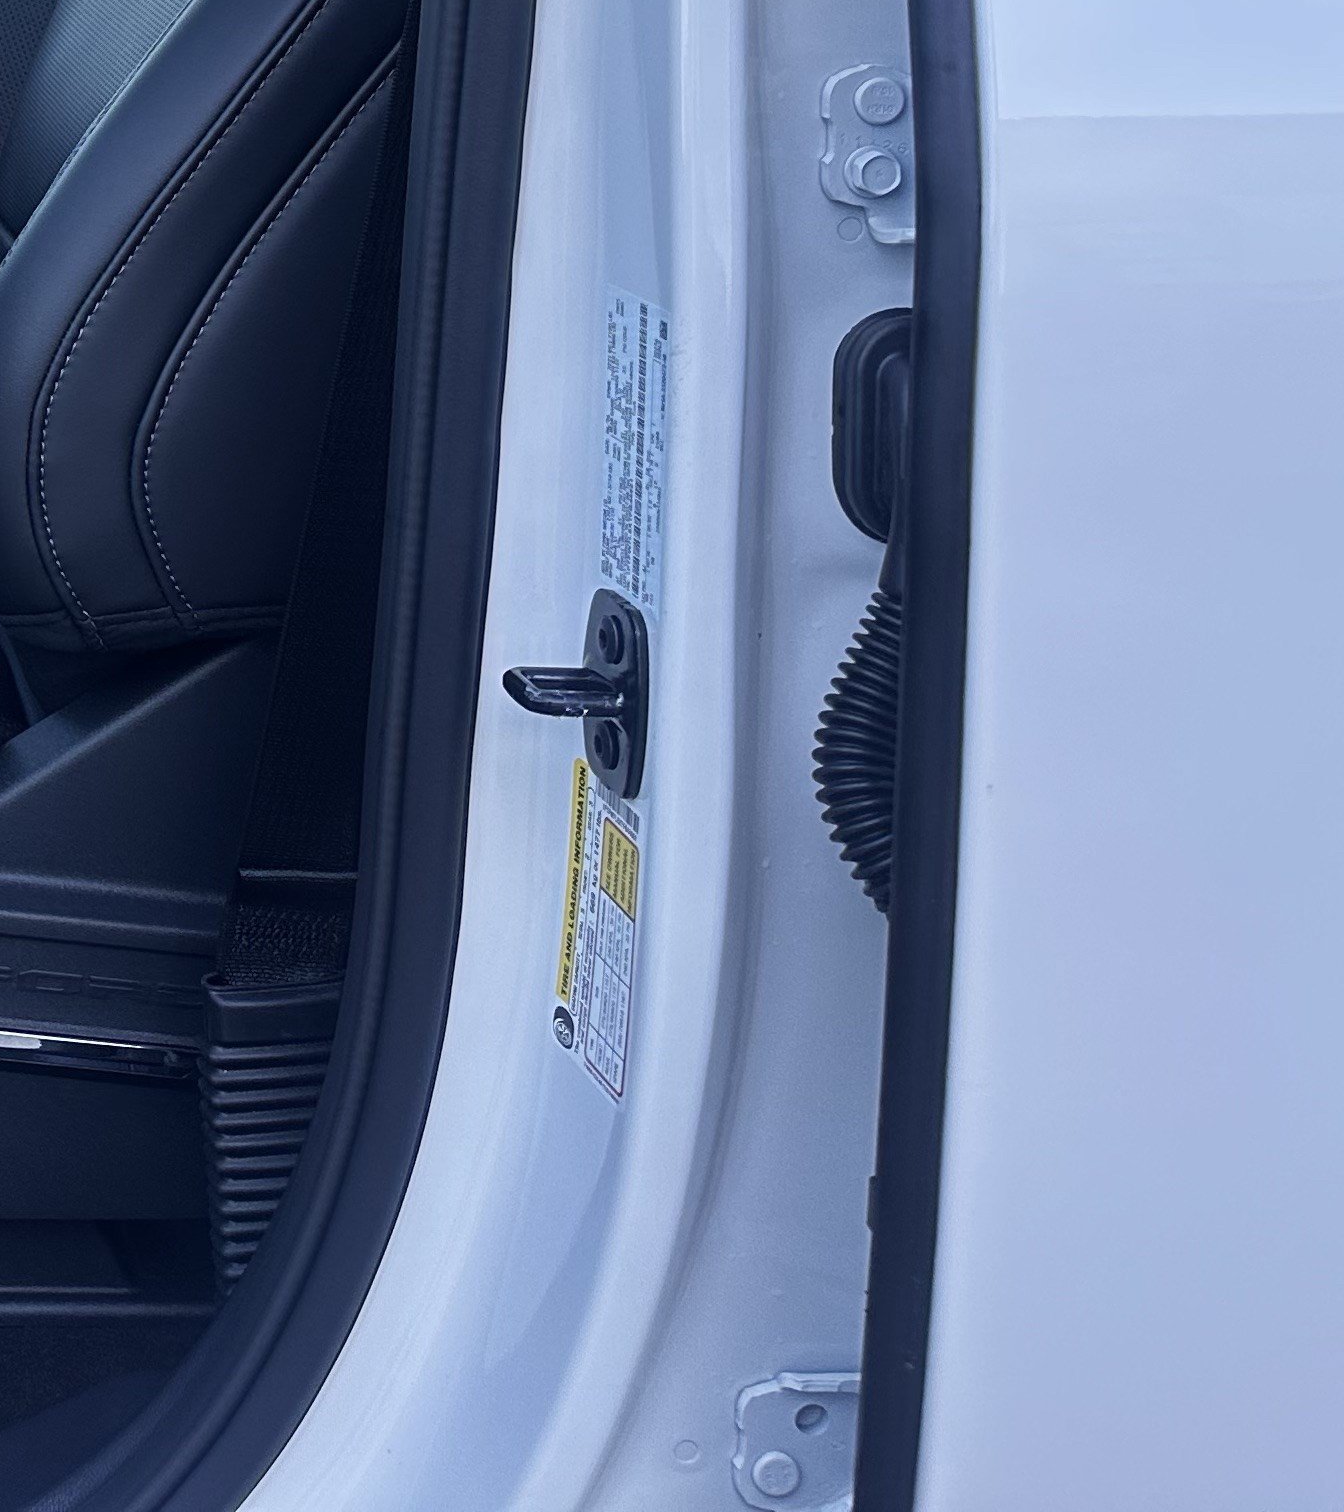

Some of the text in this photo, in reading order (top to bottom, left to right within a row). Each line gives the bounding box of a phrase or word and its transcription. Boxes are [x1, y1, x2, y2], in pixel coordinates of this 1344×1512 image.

[561, 765, 586, 998] TIRE AND LOADING INFORMATION
